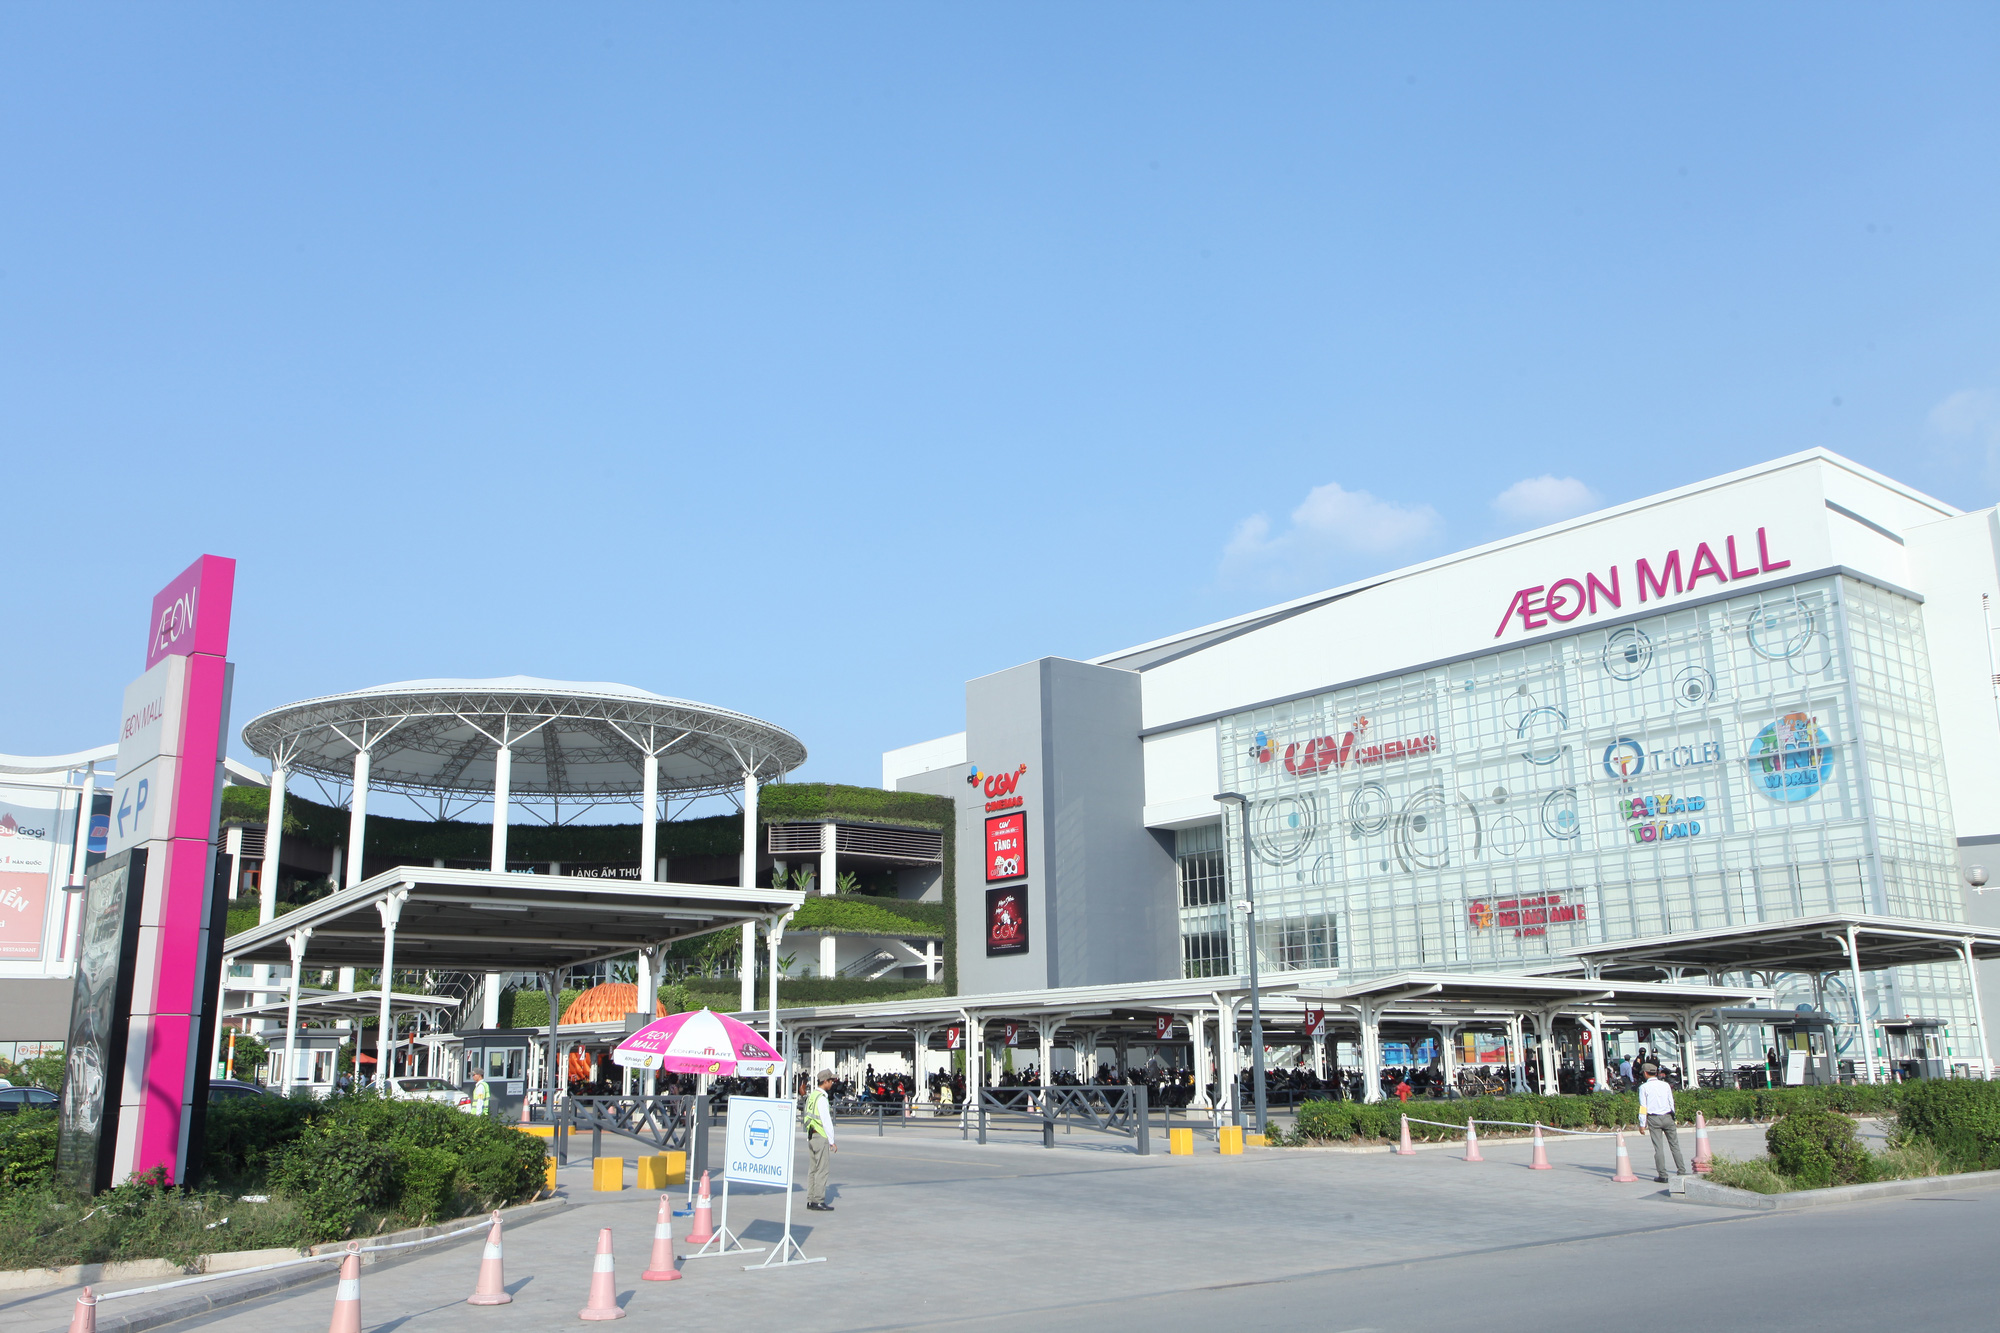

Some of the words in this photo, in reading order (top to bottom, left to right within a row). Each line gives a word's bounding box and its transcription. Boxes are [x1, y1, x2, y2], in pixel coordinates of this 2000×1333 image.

[1636, 527, 1791, 601] MALL
[141, 696, 163, 729] MALL
[1284, 731, 1355, 776] CGV
[1355, 735, 1437, 765] CINEMAS
[984, 771, 1020, 798] CGV
[1764, 769, 1819, 789] WORLD
[134, 778, 149, 832] P
[985, 796, 1024, 813] CINEMAS
[1012, 838, 1017, 849] 4
[571, 867, 598, 877] LÀNG
[1158, 1017, 1165, 1030] B
[1307, 1012, 1315, 1025] B
[948, 1030, 954, 1041] B
[1007, 1025, 1012, 1037] B
[1317, 1026, 1324, 1034] 11
[1582, 1031, 1589, 1040] B
[1639, 1029, 1645, 1038] B
[630, 1040, 660, 1050] MALL
[732, 1161, 748, 1172] CAR
[749, 1163, 782, 1176] PARKING
